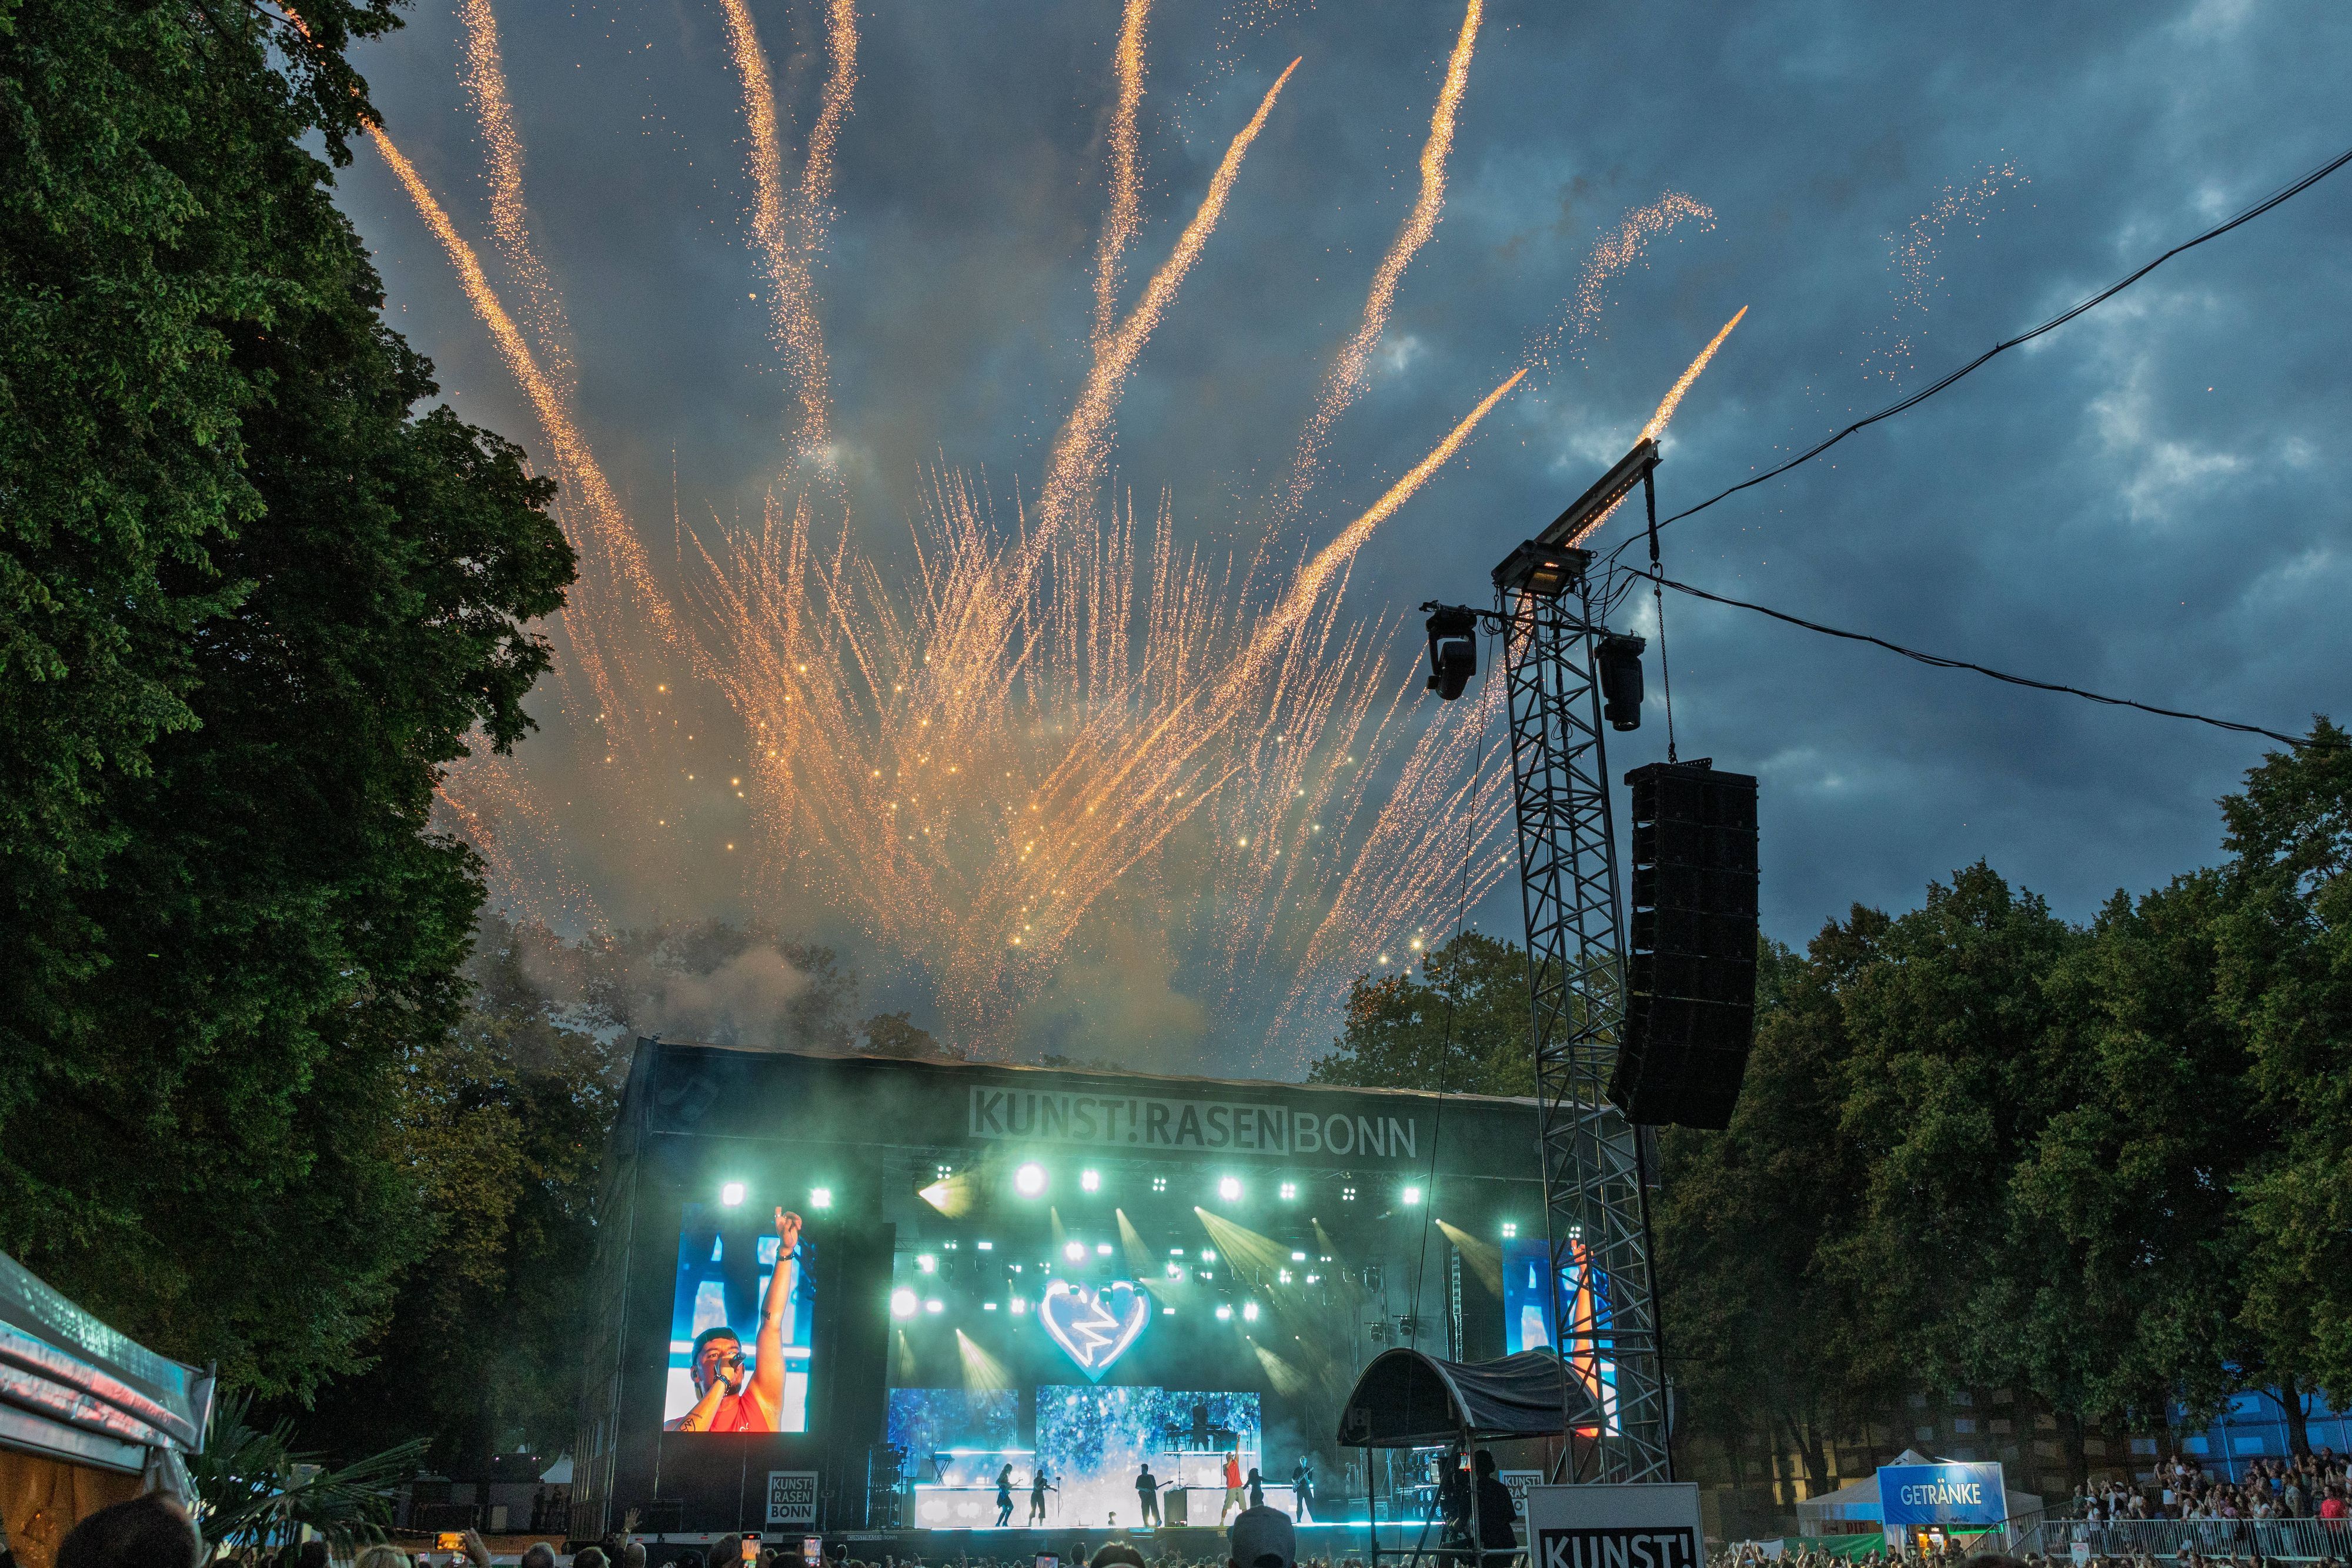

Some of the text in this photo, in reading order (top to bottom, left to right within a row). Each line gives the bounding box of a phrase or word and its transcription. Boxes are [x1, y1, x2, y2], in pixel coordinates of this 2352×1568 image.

[1294, 1112, 1416, 1158] BONN
[773, 1478, 813, 1490] KUNST!
[1505, 1476, 1540, 1486] KUNST!
[774, 1491, 810, 1503] RASEN
[1900, 1477, 1982, 1505] GETRÄNKE
[771, 1506, 811, 1518] BONN
[1545, 1533, 1691, 1568] KUNST!
